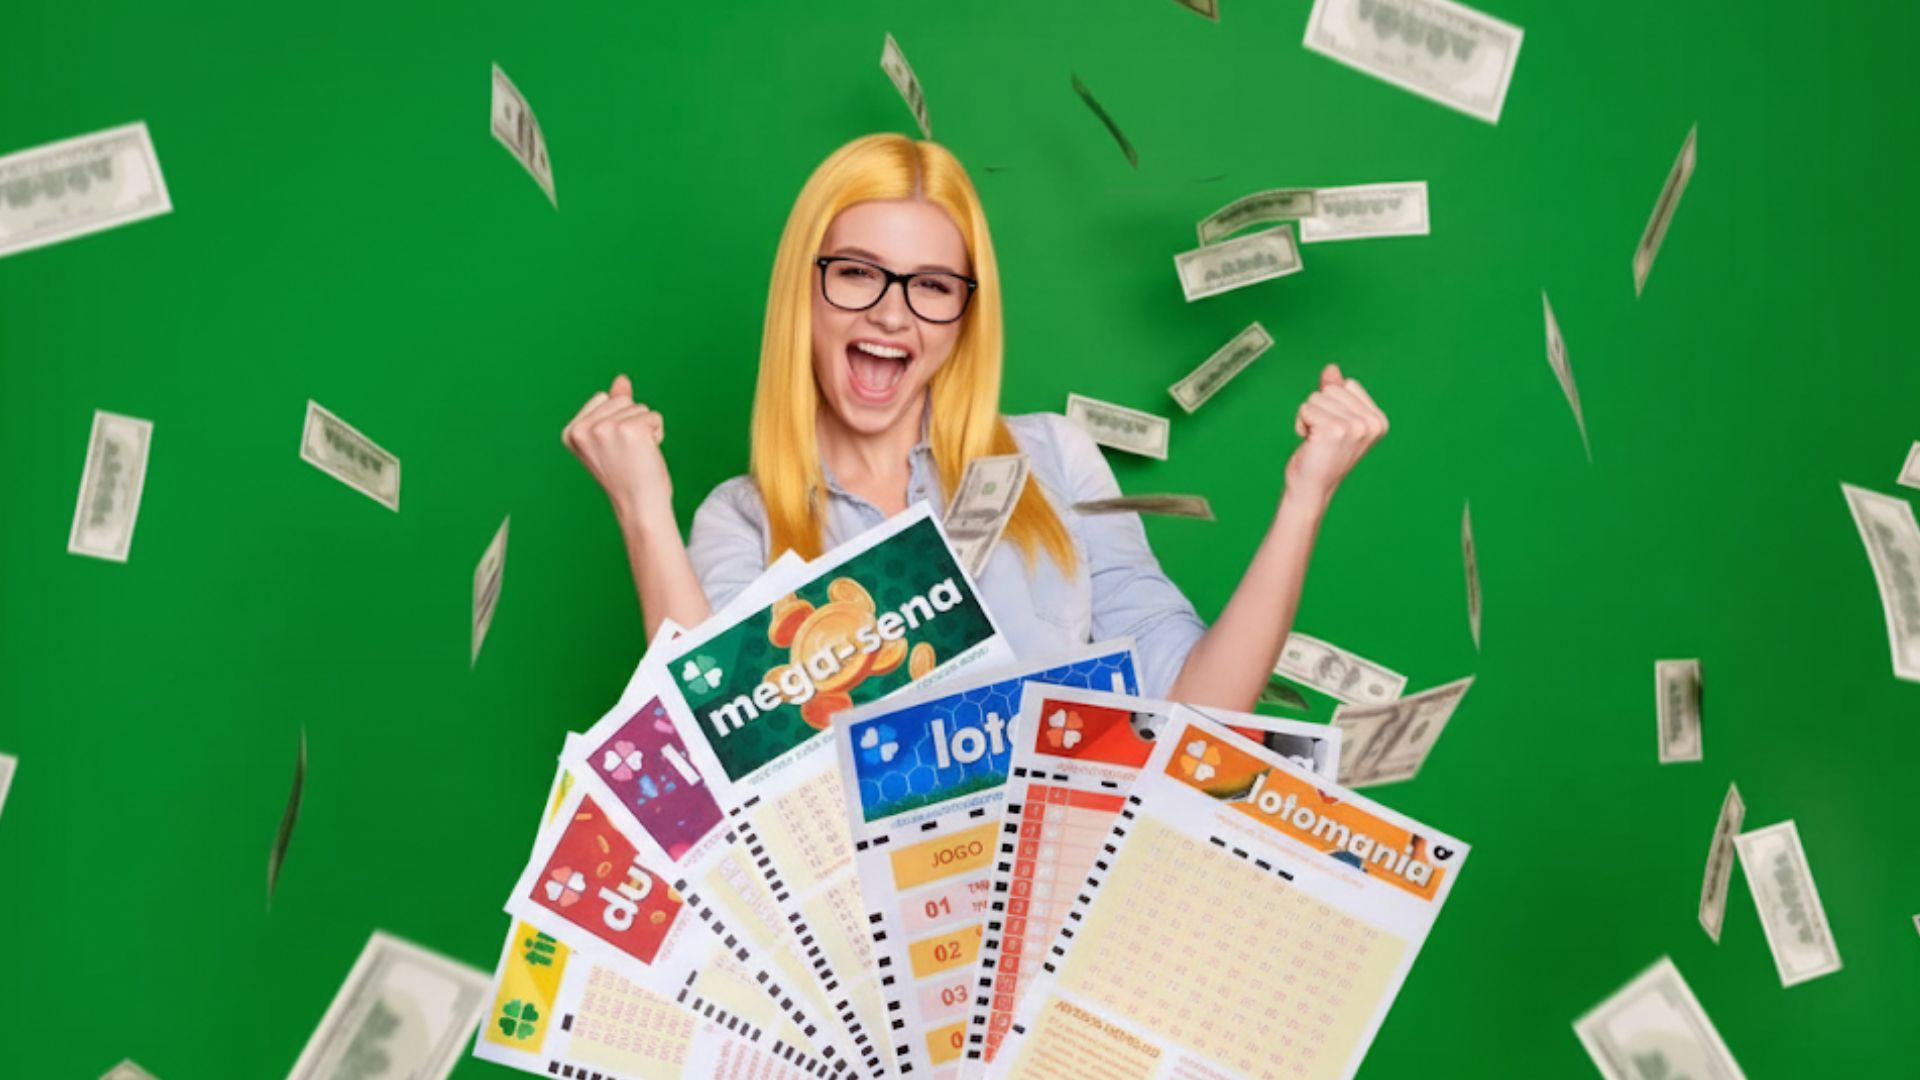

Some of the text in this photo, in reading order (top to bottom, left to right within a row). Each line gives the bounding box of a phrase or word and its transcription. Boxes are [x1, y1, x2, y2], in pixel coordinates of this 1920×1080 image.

[708, 577, 963, 738] mega-sena
[1246, 773, 1435, 888] lotomania
[931, 841, 983, 868] JOGO
[925, 896, 952, 919] 01
[934, 941, 962, 963] 02
[941, 985, 968, 1007] 03
